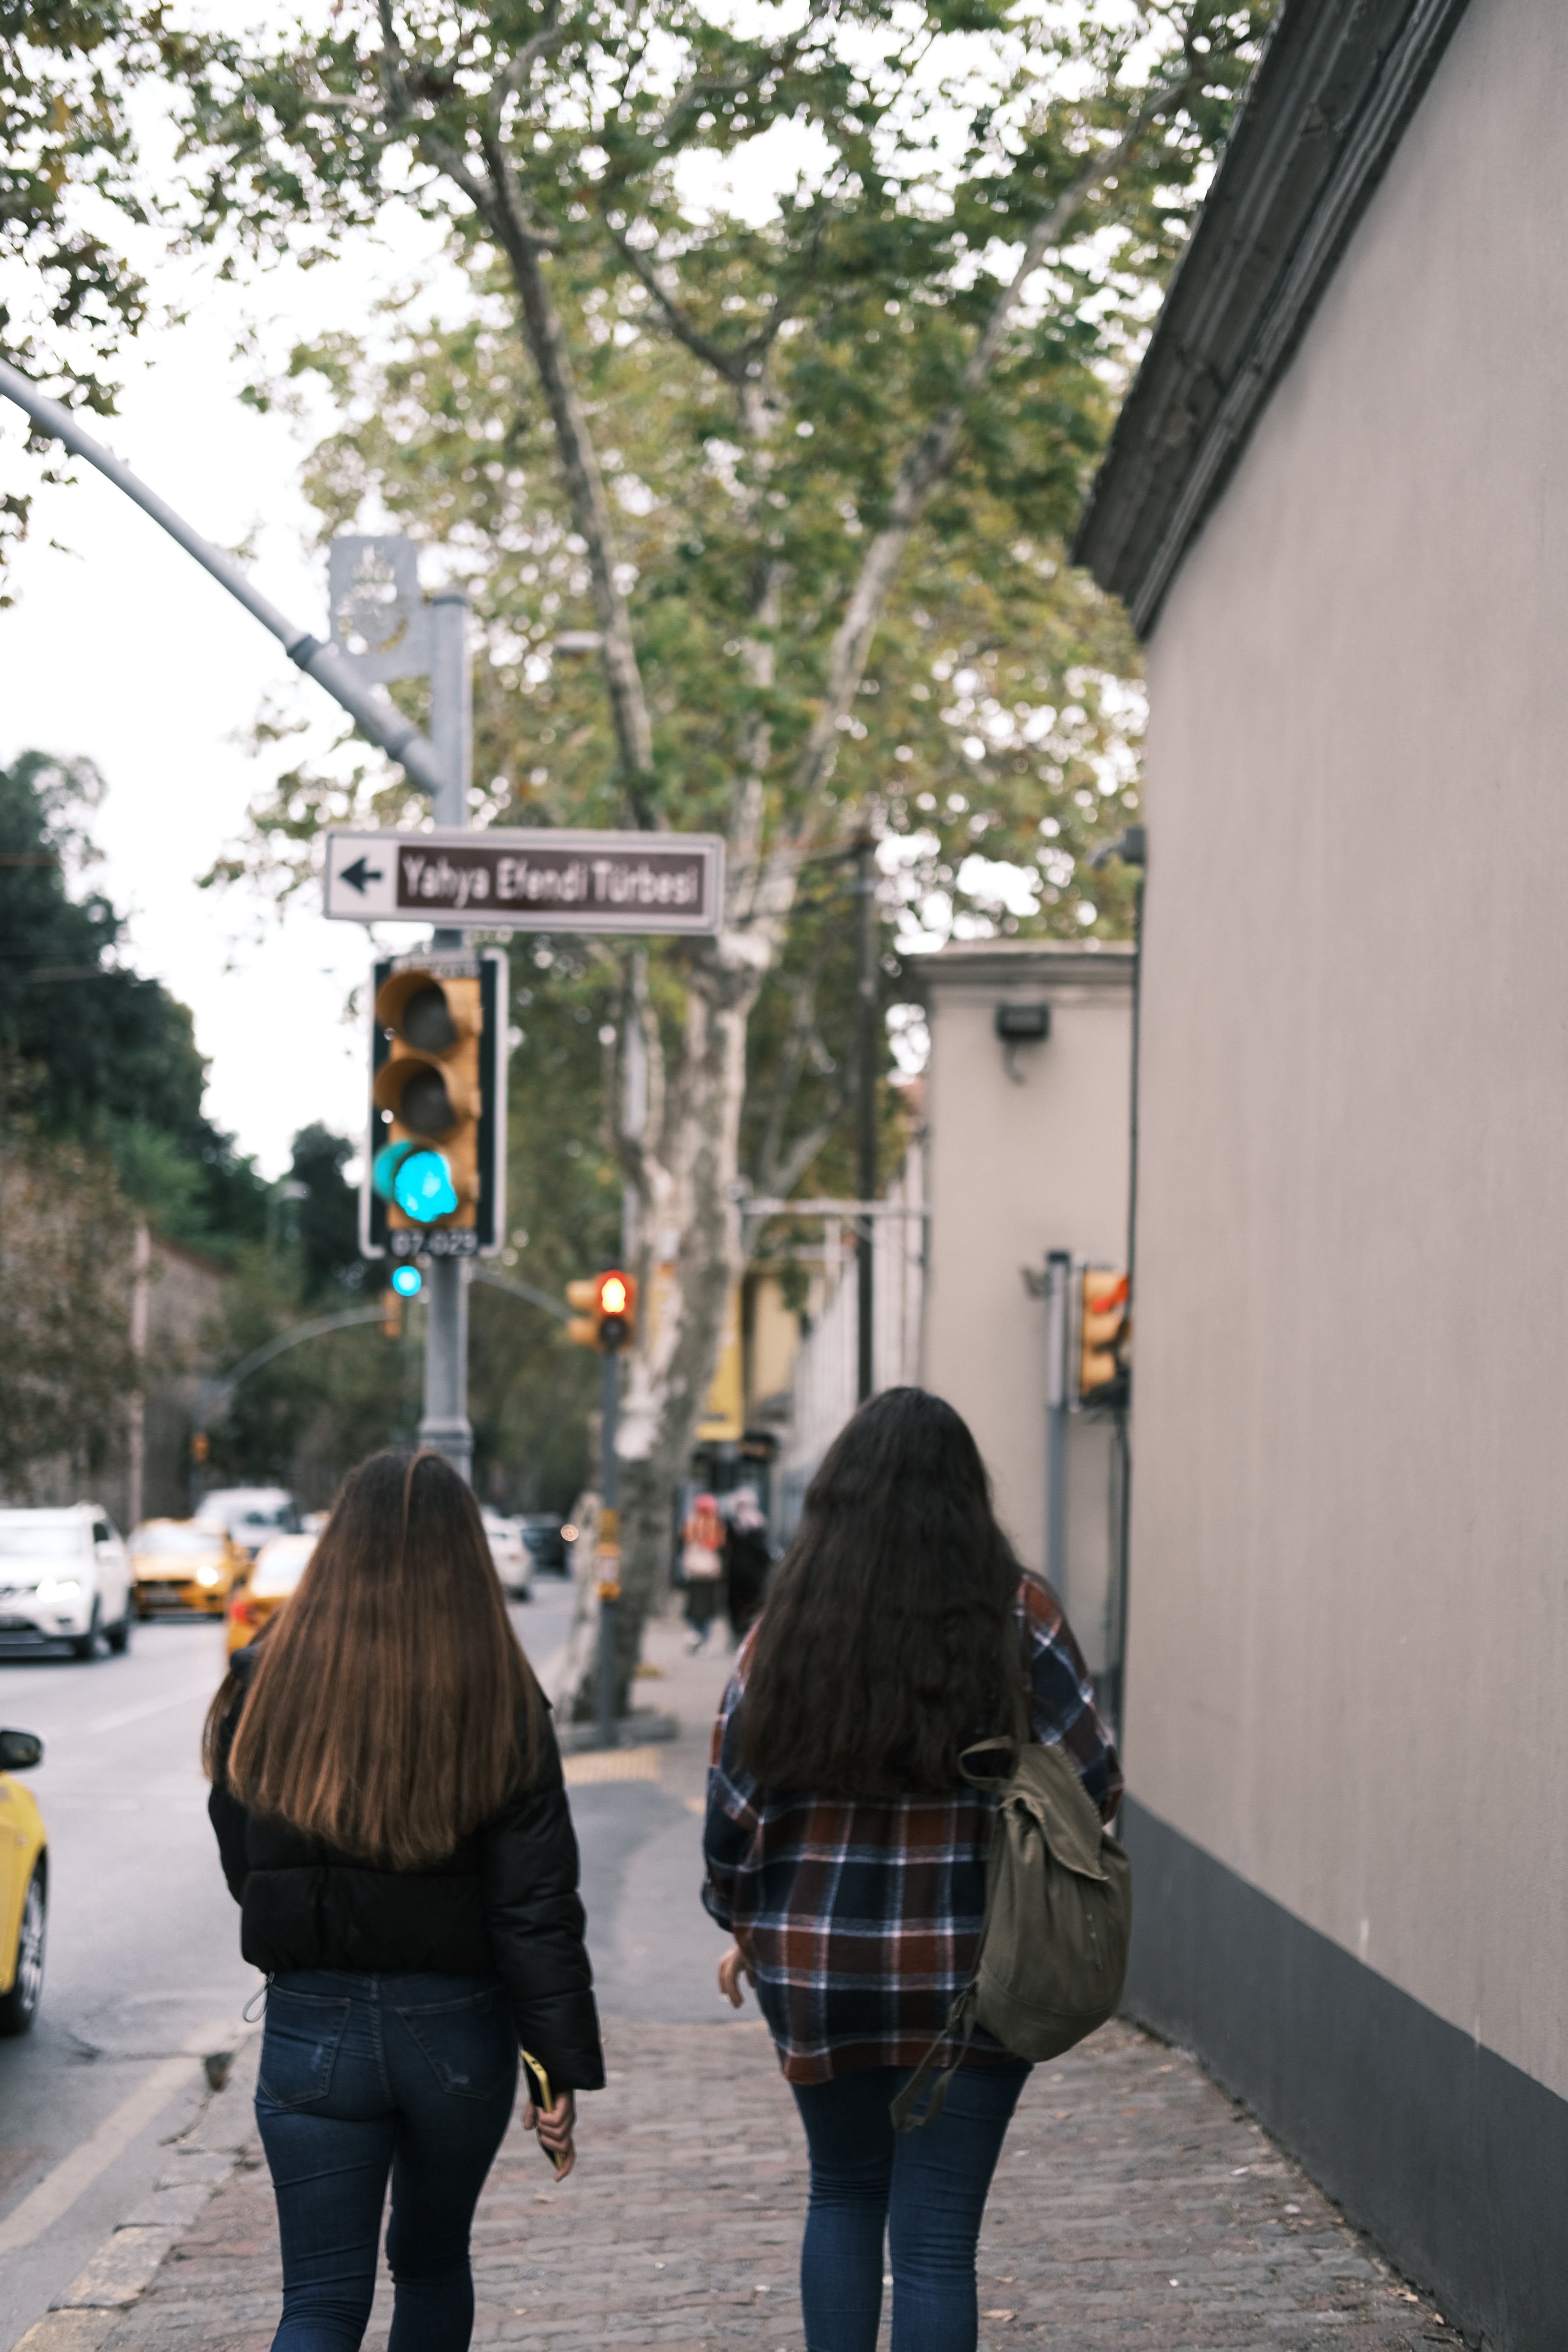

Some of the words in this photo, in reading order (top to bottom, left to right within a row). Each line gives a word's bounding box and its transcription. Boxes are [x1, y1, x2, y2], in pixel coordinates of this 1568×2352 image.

[403, 855, 489, 907] Yahya
[497, 858, 587, 901] Efendi
[592, 861, 697, 903] Türbesi
